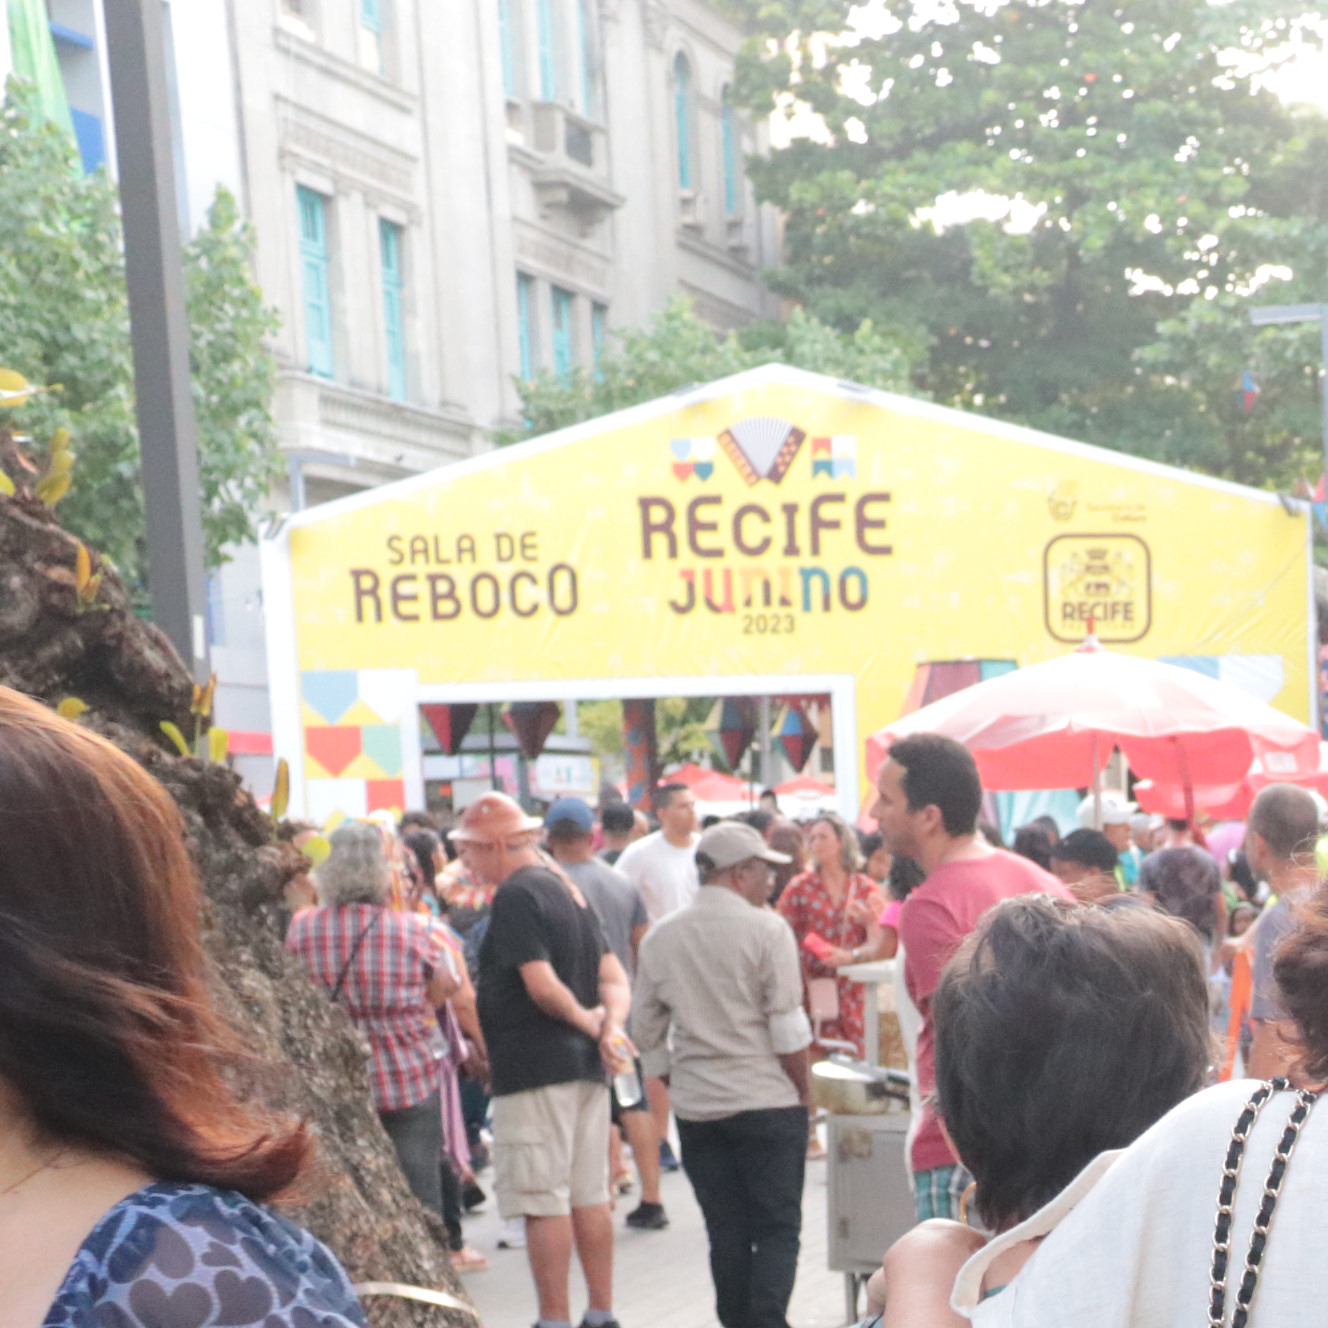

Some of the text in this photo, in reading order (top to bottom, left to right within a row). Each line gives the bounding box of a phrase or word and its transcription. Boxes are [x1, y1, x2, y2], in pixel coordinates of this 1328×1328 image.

[638, 492, 893, 559] RECIFE
[387, 531, 538, 565] SALA DE
[350, 562, 578, 623] REBOCO
[743, 614, 795, 634] 2023
[1062, 602, 1133, 621] RECIFE
